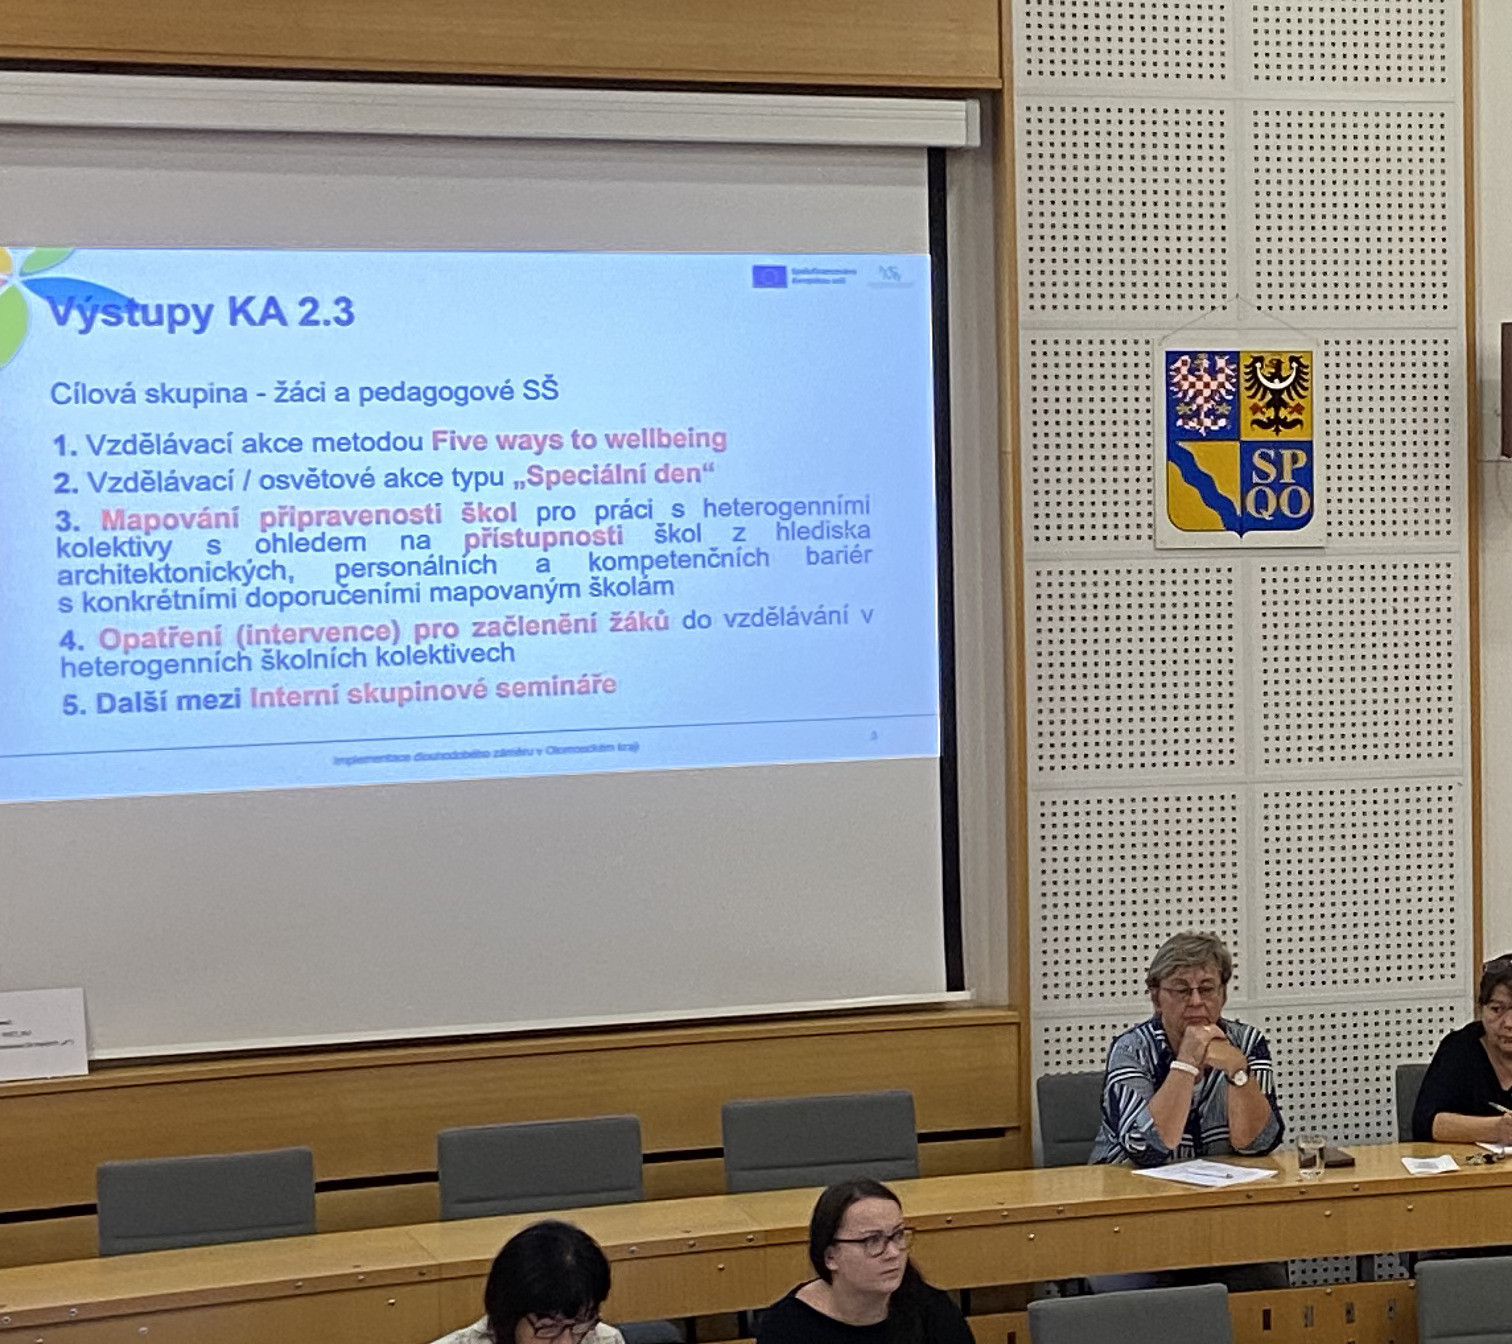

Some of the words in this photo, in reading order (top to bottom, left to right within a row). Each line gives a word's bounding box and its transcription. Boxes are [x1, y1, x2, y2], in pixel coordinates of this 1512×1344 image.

[47, 295, 215, 335] Výstupy
[228, 295, 289, 327] KA
[298, 295, 356, 327] 2.3
[50, 381, 137, 405] Cílová
[145, 382, 248, 409] skupina
[273, 379, 326, 403] žáci
[334, 385, 351, 402] a
[358, 379, 515, 407] pedagogové
[522, 374, 560, 401] SŠ
[53, 434, 78, 456] 1.
[86, 431, 234, 456] Vzdělávací
[241, 432, 304, 454] akce
[311, 431, 424, 453] metodou
[431, 430, 489, 452] Five
[495, 433, 565, 456] ways
[570, 429, 598, 450] to
[604, 427, 728, 453] wellbeing
[53, 471, 79, 494] 2.
[87, 468, 235, 493] Vzdělávací
[242, 469, 252, 492] /
[258, 466, 376, 491] osvětové
[383, 467, 444, 489] akce
[451, 467, 505, 492] typu
[513, 462, 647, 491] „Speciální
[654, 462, 715, 485] den“
[1252, 448, 1307, 484] SP
[55, 509, 80, 532] 3.
[101, 505, 240, 536] Mapování
[259, 502, 443, 532] připravenosti
[461, 501, 518, 524] škol
[536, 505, 577, 527] pro
[594, 498, 654, 525] práci
[671, 502, 686, 519] s
[702, 494, 871, 520] heterogenními
[1245, 485, 1311, 520] QO
[56, 536, 173, 562] kolektivy
[205, 539, 222, 556] s
[255, 532, 367, 554] ohledem
[400, 533, 431, 551] na
[464, 524, 624, 553] přístupnosti
[654, 522, 702, 544] škol
[731, 526, 747, 542] z
[775, 520, 871, 542] hlediska
[57, 559, 294, 586] architektonických,
[335, 553, 498, 580] personálních
[535, 557, 551, 574] a
[588, 545, 770, 574] kompetenčních
[806, 543, 873, 566] bariér
[57, 596, 74, 614] s
[82, 587, 238, 613] konkrétními
[245, 581, 421, 613] doporučeními
[429, 577, 582, 606] mapovaným
[588, 574, 675, 599] školám
[59, 629, 85, 652] 4.
[99, 623, 223, 654] Opatření
[236, 619, 400, 652] (intervence)
[414, 621, 460, 645] pro
[471, 612, 598, 638] začlenění
[609, 609, 671, 634] žáků
[683, 609, 713, 632] do
[724, 604, 850, 629] vzdělávání
[861, 609, 875, 625] v
[60, 650, 253, 680] heterogenních
[261, 646, 368, 672] školních
[375, 641, 516, 668] kolektivech
[62, 693, 87, 717] 5.
[96, 689, 168, 715] Další
[176, 687, 242, 712] mezi
[251, 682, 340, 710] Interní
[347, 677, 488, 707] skupinové
[495, 672, 618, 699] semináře
